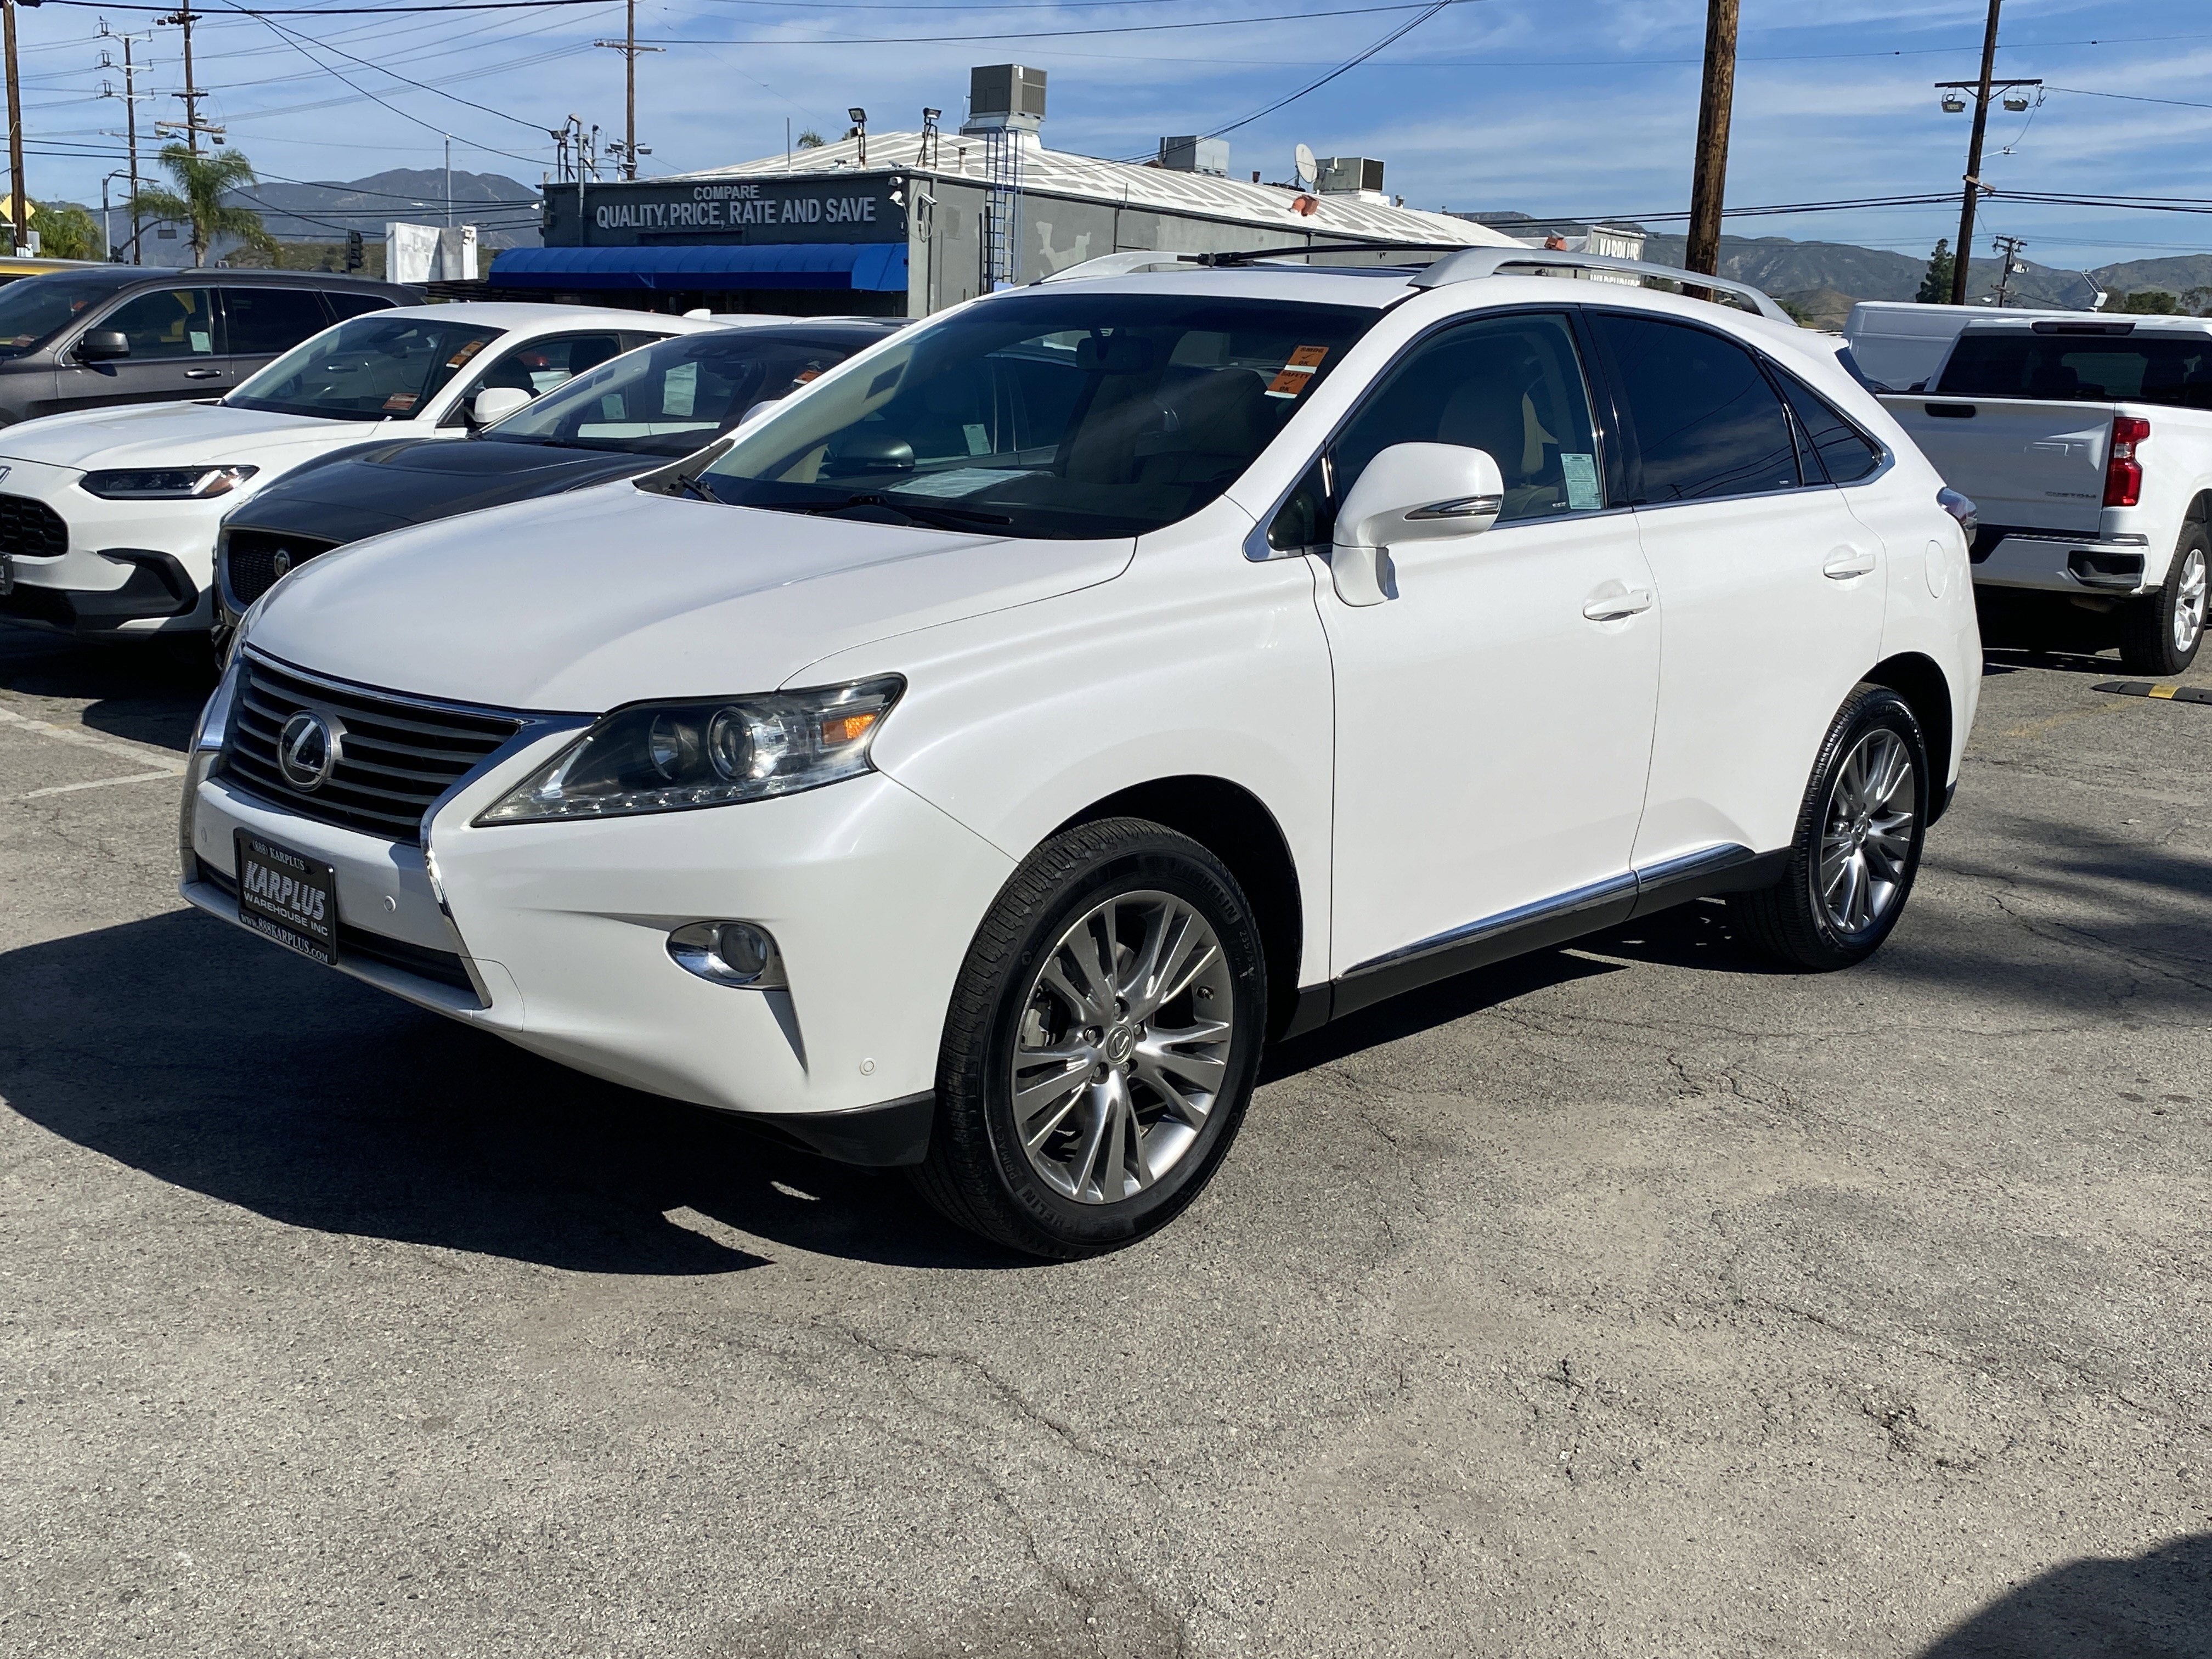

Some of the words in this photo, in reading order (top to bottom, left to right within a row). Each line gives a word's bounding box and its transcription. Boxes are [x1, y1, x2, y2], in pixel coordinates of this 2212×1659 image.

[693, 184, 760, 200] COMPARE
[596, 204, 668, 230] QUALITY,
[669, 200, 725, 230] PRICE,
[729, 199, 777, 224] RATE
[781, 198, 822, 223] AND
[825, 196, 877, 223] SAVE
[252, 840, 269, 856] (888)
[269, 848, 306, 871] KARPLUS
[244, 860, 325, 921] KARPLUS
[244, 891, 308, 927] WAREHOUSE
[311, 921, 329, 936] INC
